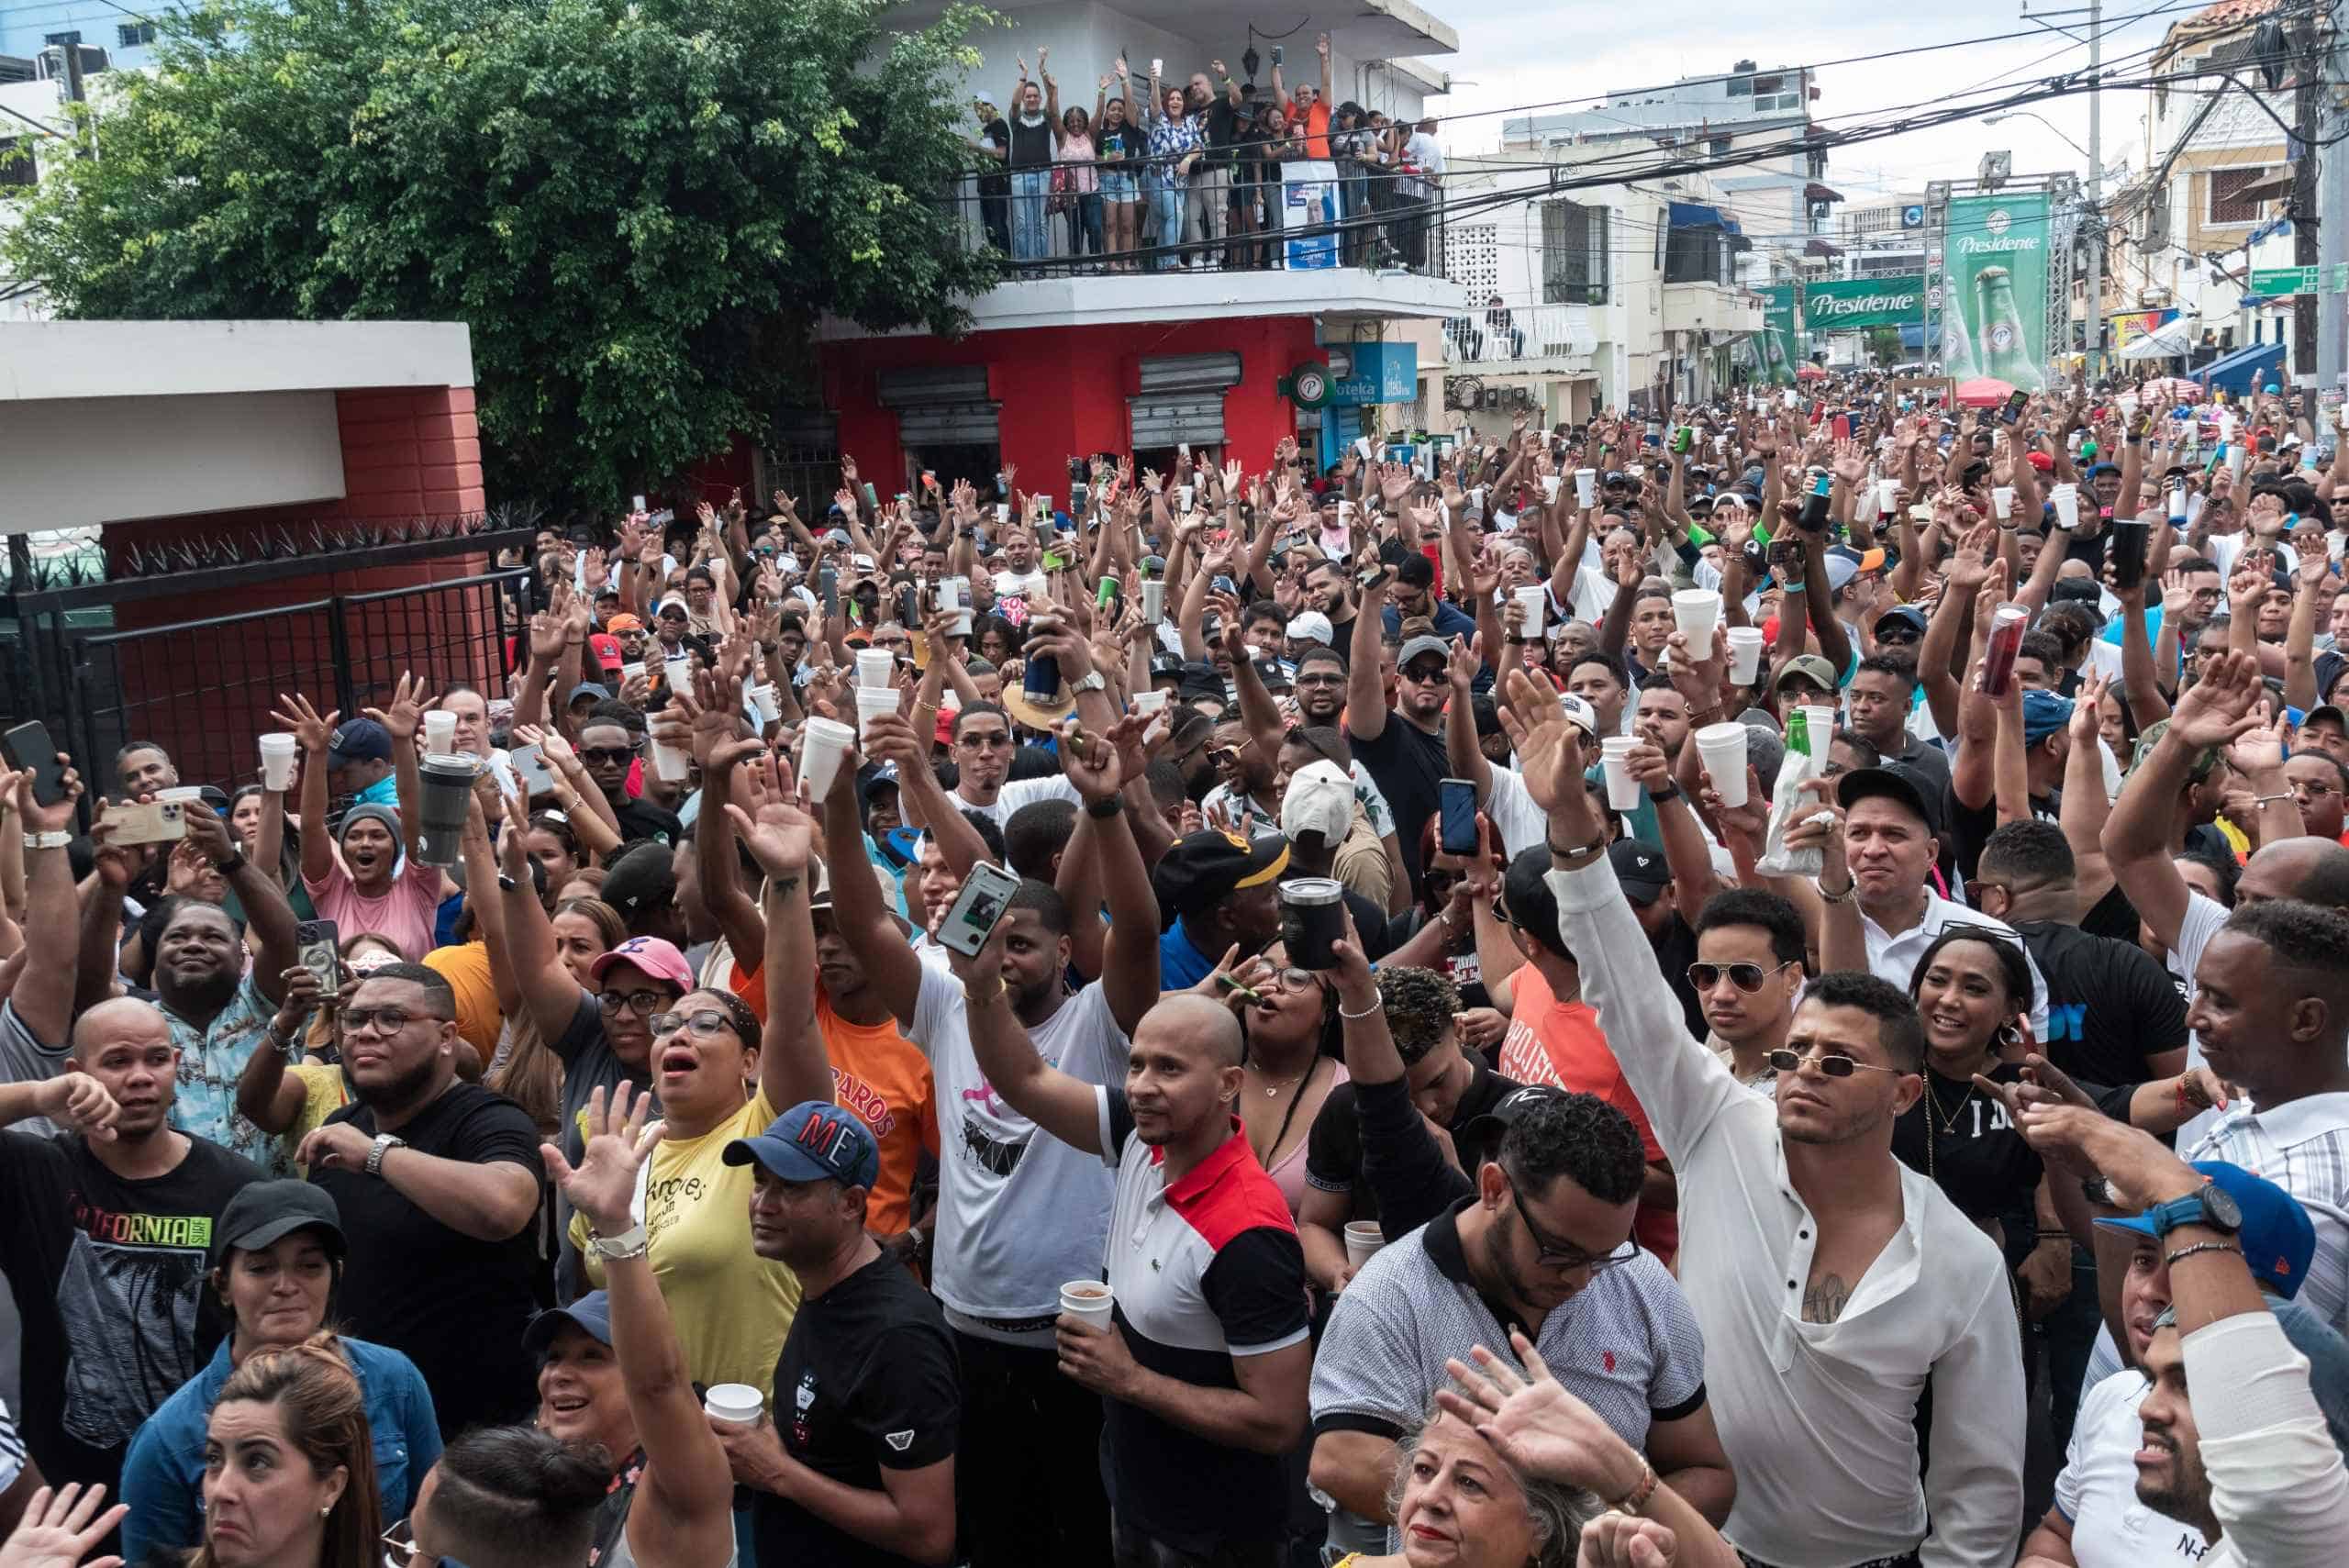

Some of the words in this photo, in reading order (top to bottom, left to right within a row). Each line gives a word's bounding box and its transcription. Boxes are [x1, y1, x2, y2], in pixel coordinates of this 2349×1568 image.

[1956, 236, 2040, 255] Presidente
[1811, 293, 1914, 316] Presidente
[1336, 381, 1375, 396] oteka
